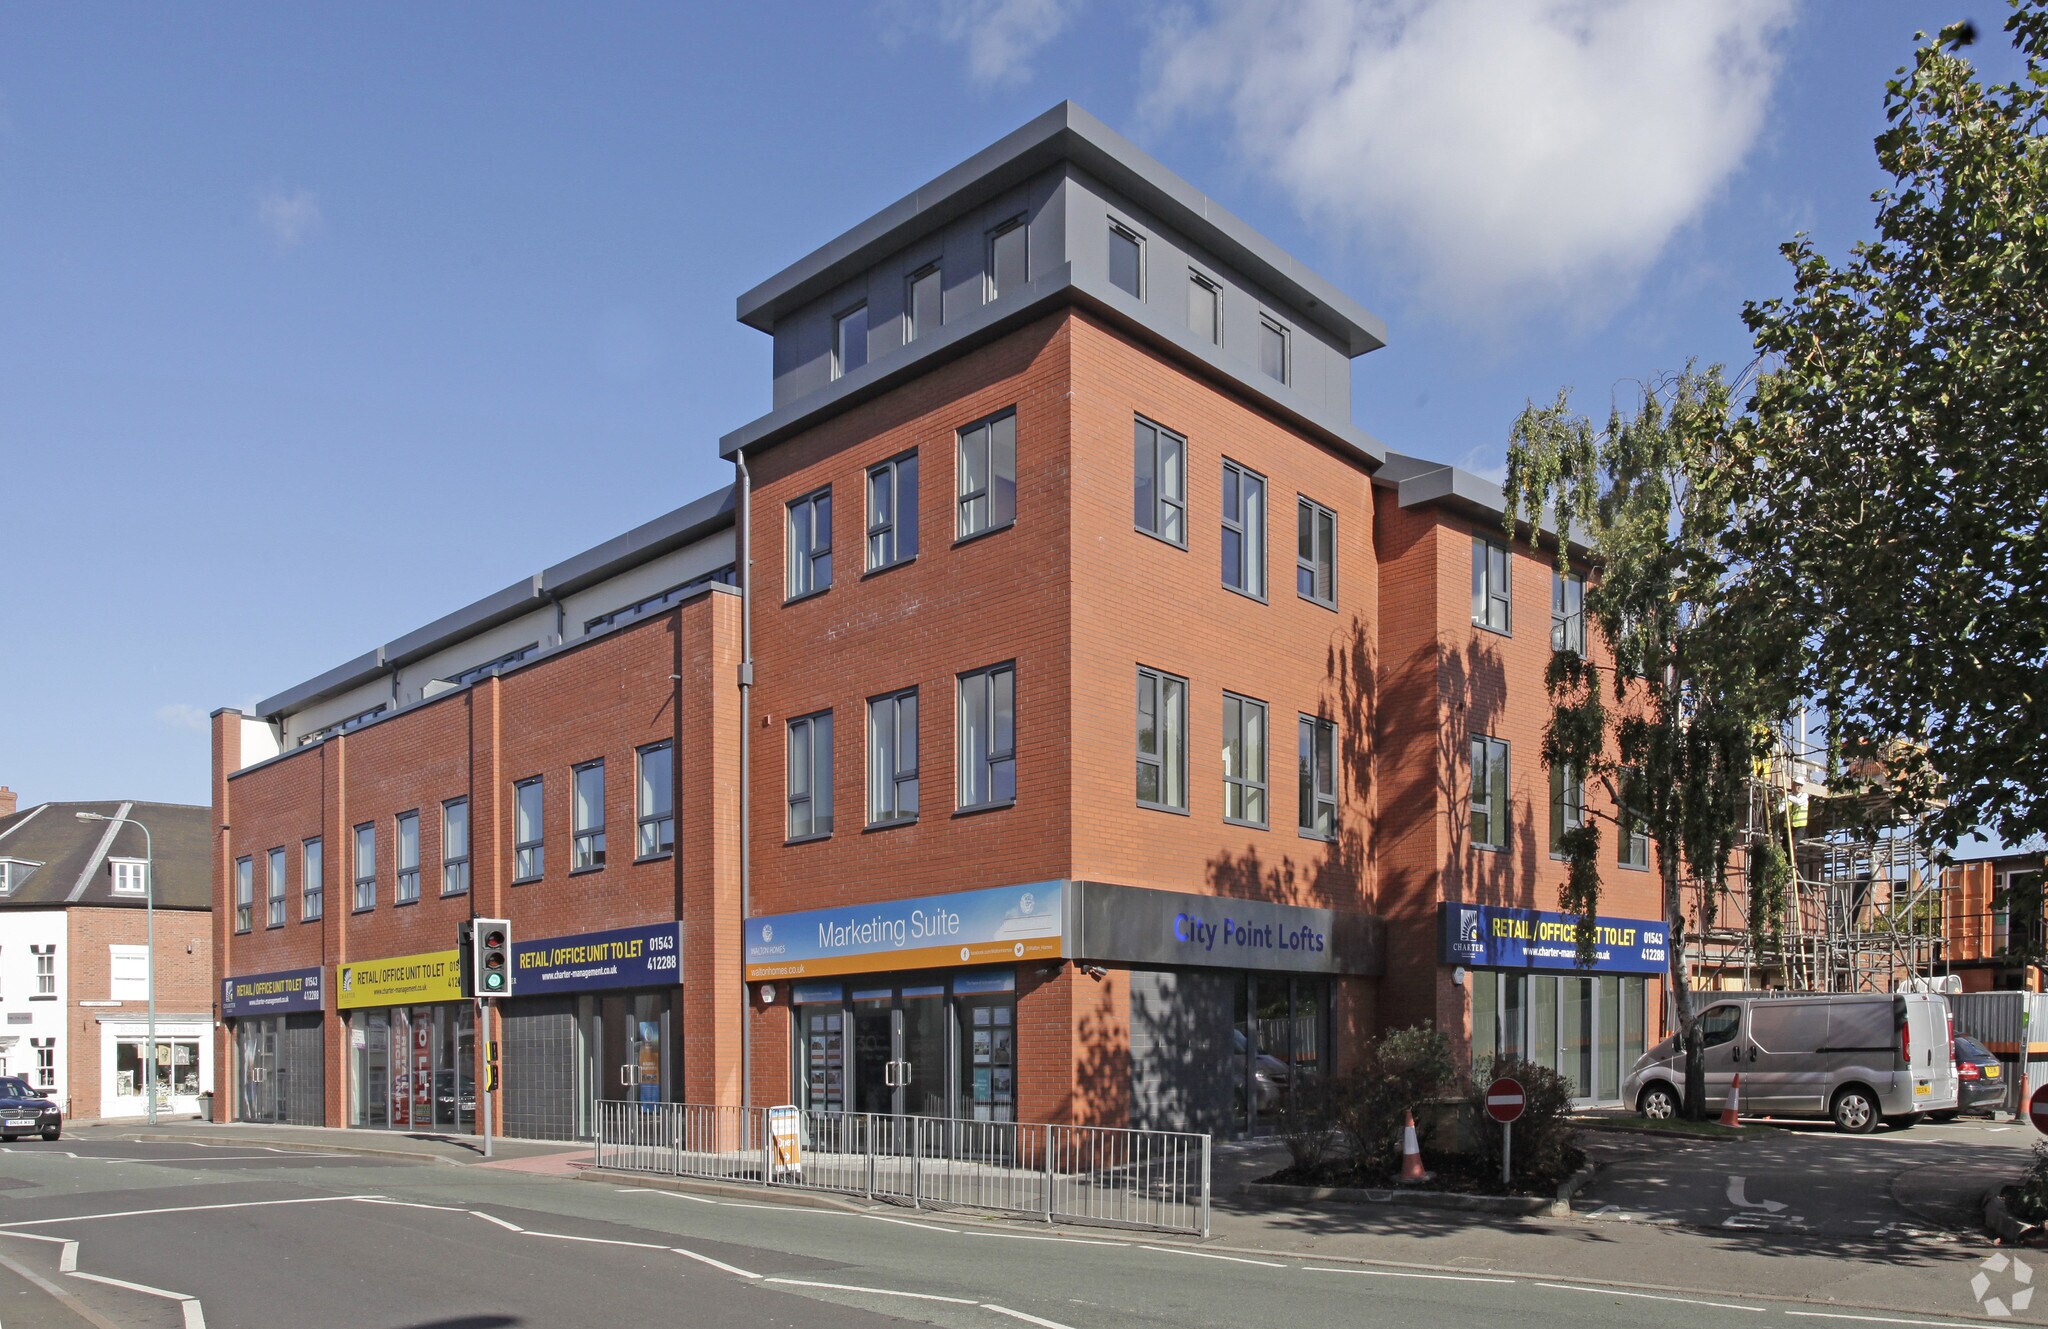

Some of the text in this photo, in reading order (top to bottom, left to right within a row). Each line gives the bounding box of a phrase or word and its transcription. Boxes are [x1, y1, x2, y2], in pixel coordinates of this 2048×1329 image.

[819, 908, 960, 947] Marketing Suite
[1173, 912, 1324, 952] City Point Lofts
[1492, 917, 1531, 940] RETAIL
[1540, 922, 1577, 943] OFFICE
[1604, 927, 1617, 945] TO
[1618, 928, 1636, 946] LET
[650, 936, 673, 951] 01543
[1643, 931, 1663, 945] 01543
[519, 951, 549, 969] RETAIL
[555, 946, 586, 965] OFFICE
[586, 944, 610, 962] UNIT
[611, 942, 624, 960] TO
[624, 939, 643, 958] LET
[751, 945, 786, 956] WALTON HOMES
[1453, 943, 1484, 952] CHARTER
[1641, 948, 1665, 961] 412288
[450, 961, 459, 973] 015
[647, 955, 677, 970] 412288
[357, 970, 378, 985] RETAIL
[382, 967, 405, 982] OFFICE
[405, 965, 421, 980] UNIT
[422, 964, 432, 979] TO
[431, 963, 445, 978] LET
[542, 965, 617, 980] www.charter-management.co.uk
[751, 965, 805, 977] waltonhomes.co.uk
[236, 983, 252, 997] RETAIL
[256, 981, 273, 995] OFFICE
[273, 980, 285, 993] UNIT
[286, 979, 293, 991] TO
[292, 978, 302, 991] LET
[418, 1018, 427, 1047] TO
[418, 1056, 428, 1101] LET
